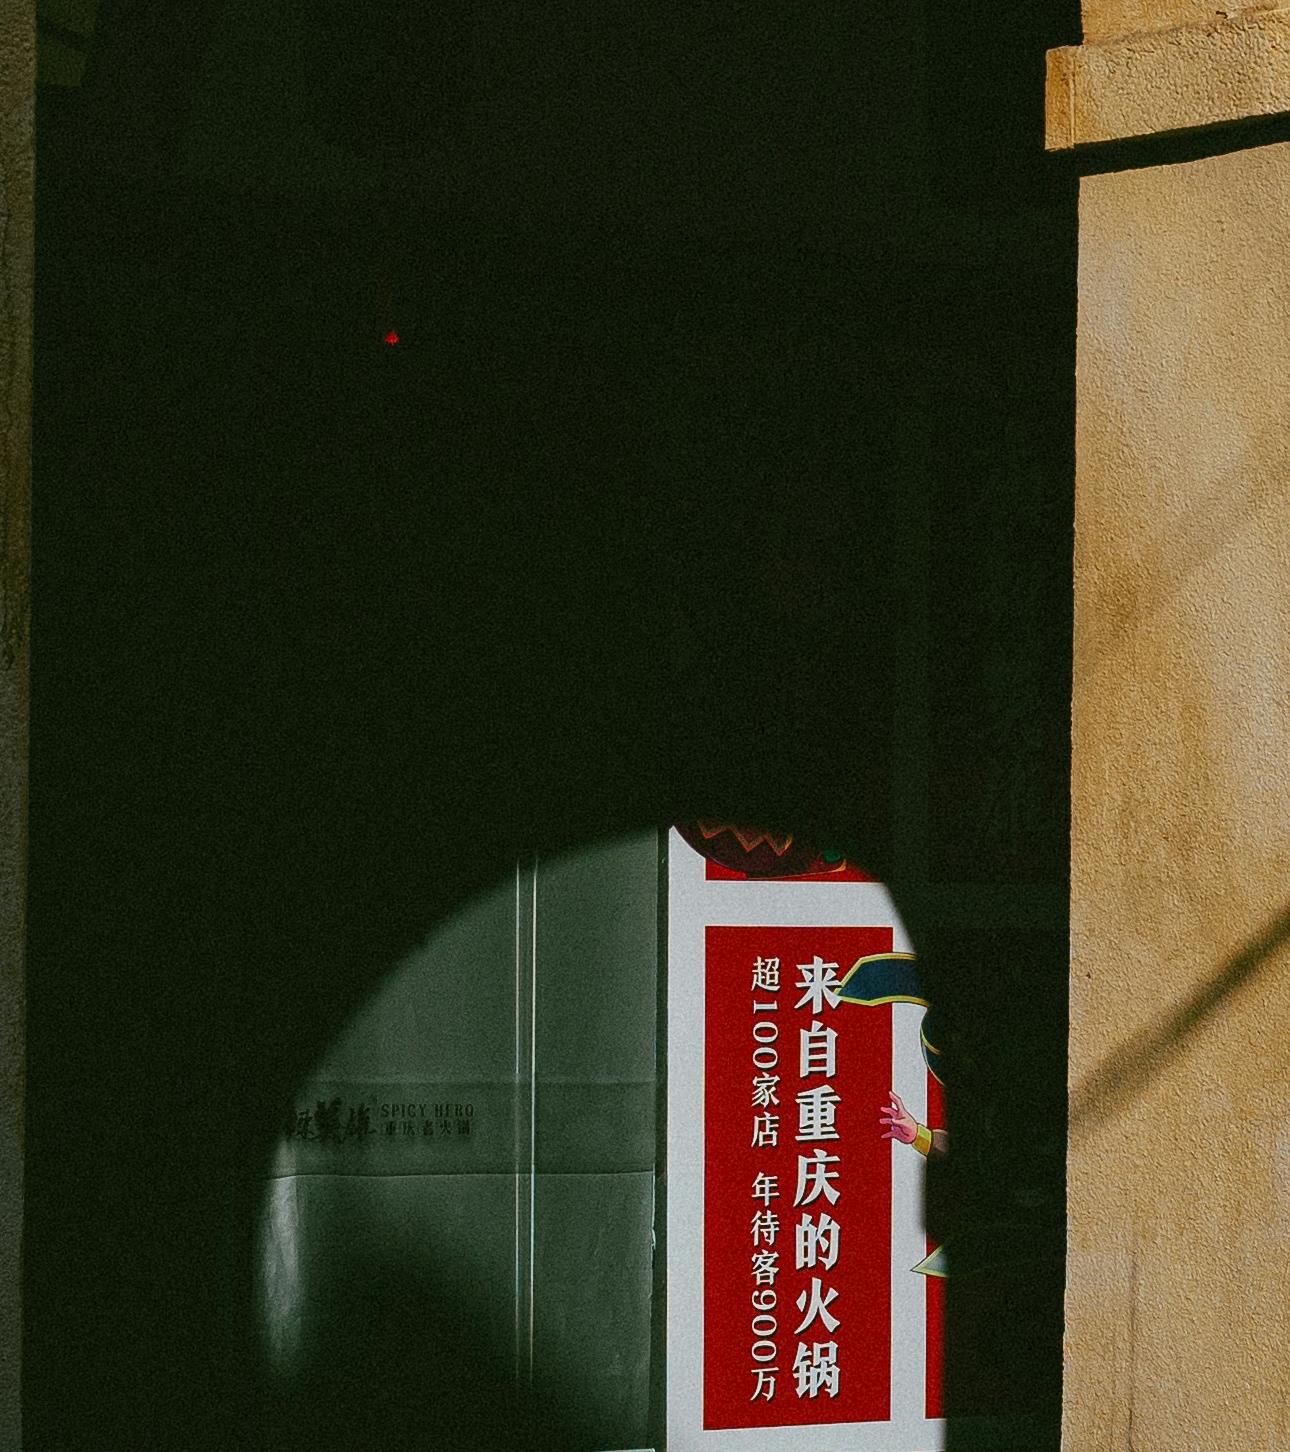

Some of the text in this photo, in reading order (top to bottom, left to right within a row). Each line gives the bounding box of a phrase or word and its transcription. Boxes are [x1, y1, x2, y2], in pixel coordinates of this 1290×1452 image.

[380, 1102, 475, 1118] SPICY HERO
[749, 955, 781, 1402] 超100家店 年待客900万
[793, 955, 843, 1399] 来自重庆的火锅
